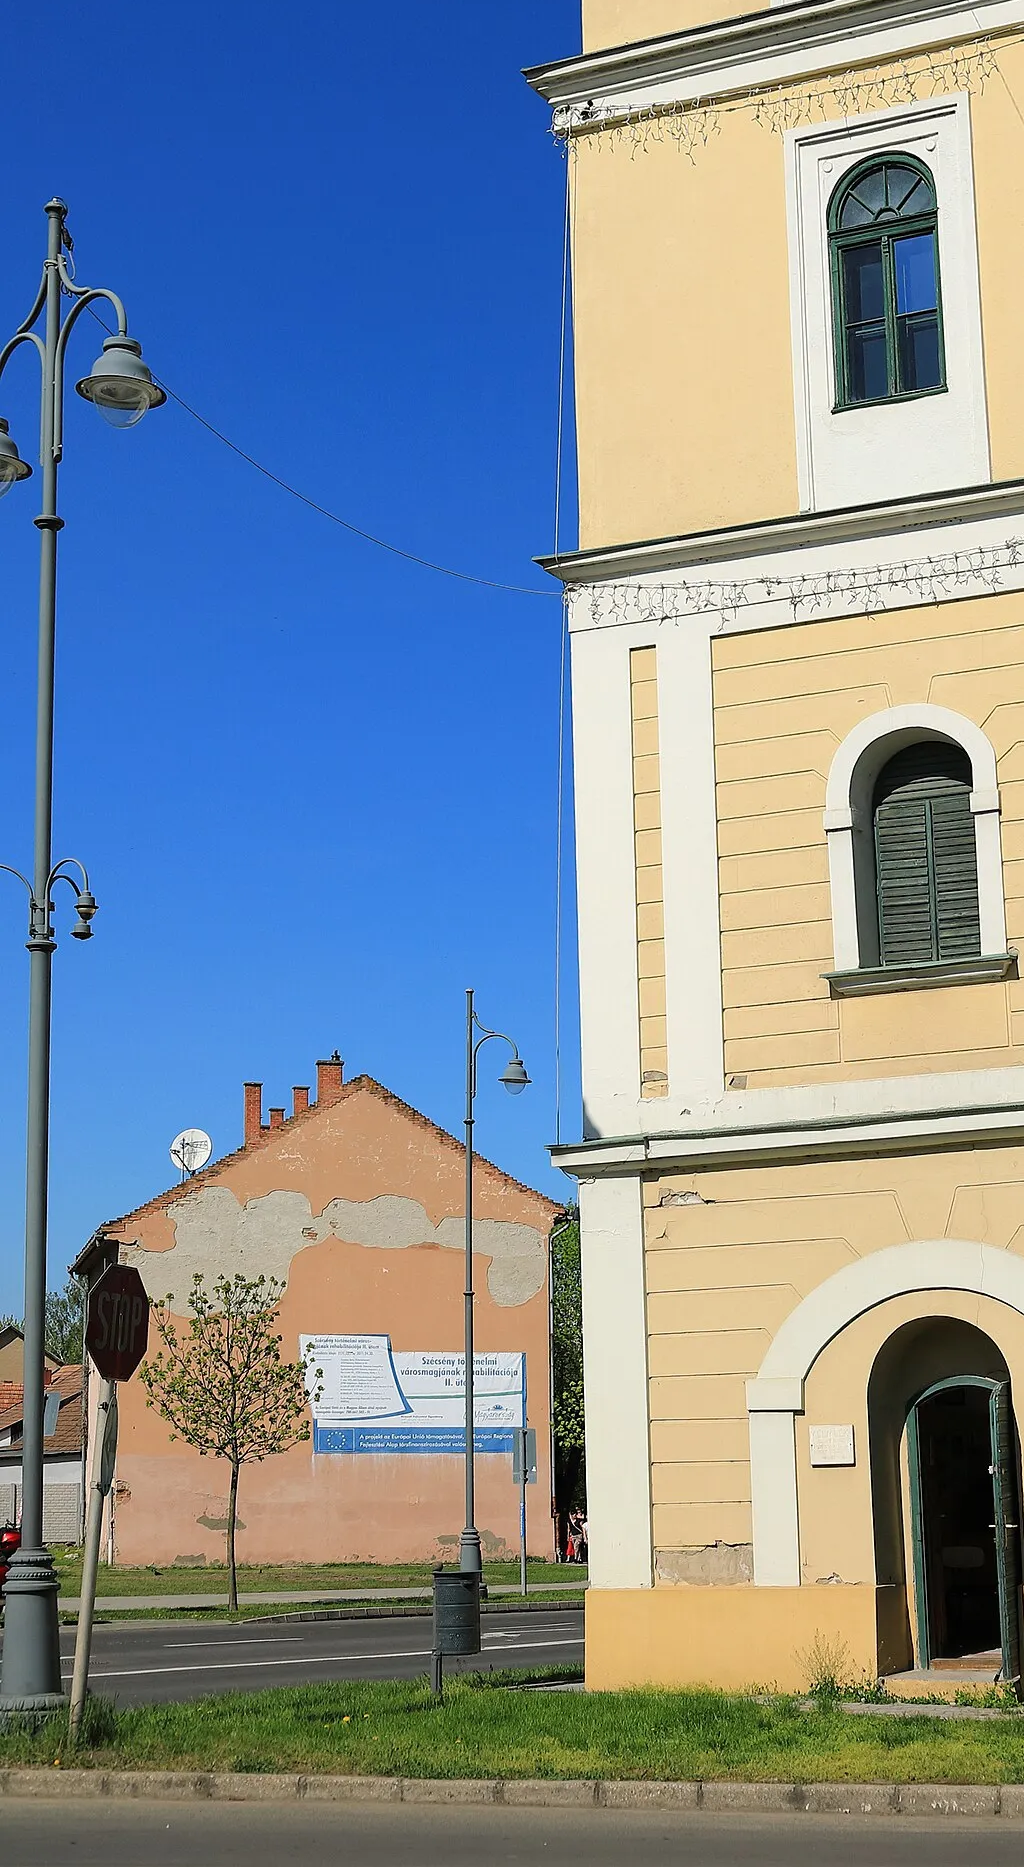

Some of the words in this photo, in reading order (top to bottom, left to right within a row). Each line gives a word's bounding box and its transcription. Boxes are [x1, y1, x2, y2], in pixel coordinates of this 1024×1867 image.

[95, 1290, 143, 1353] STOP
[422, 1356, 456, 1367] Szécsény
[400, 1367, 461, 1378] városmagjának
[462, 1367, 518, 1378] rabilitációja
